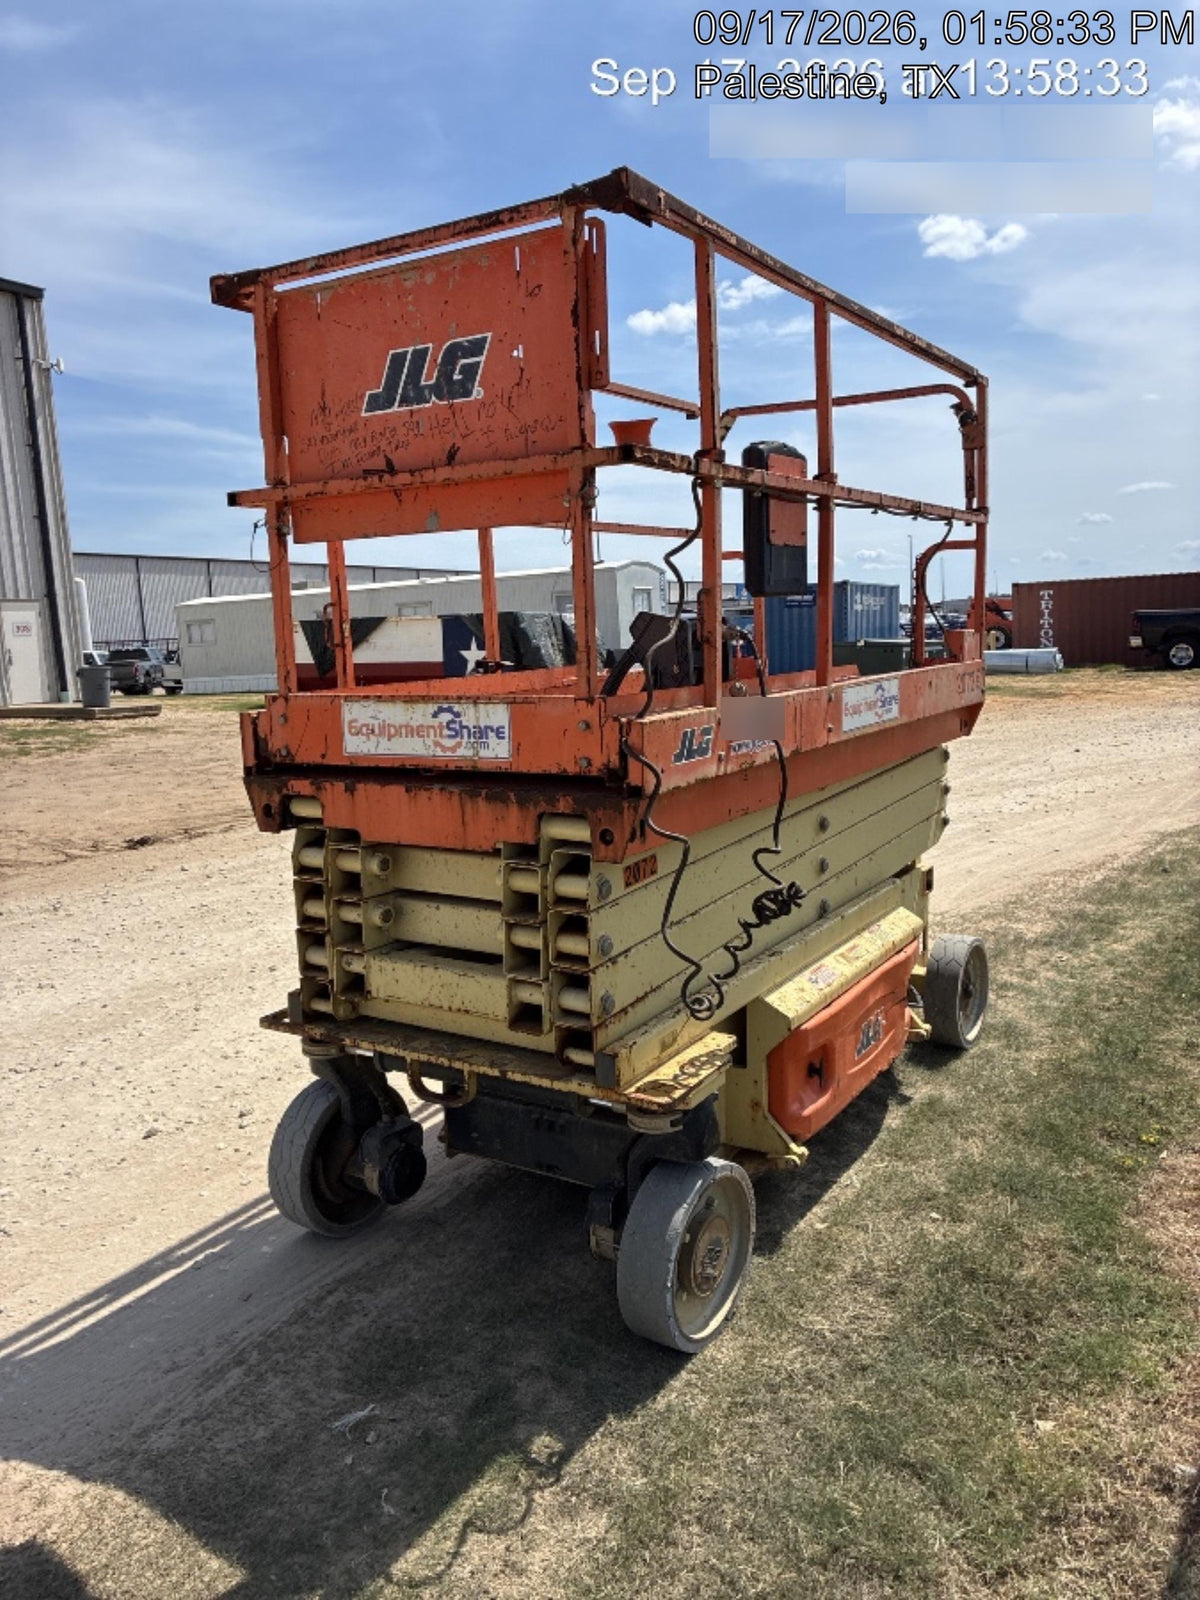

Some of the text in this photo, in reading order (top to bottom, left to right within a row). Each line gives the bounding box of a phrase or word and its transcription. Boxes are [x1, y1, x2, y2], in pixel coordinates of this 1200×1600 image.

[361, 332, 492, 416] JLG
[1039, 589, 1054, 648] TRITON
[671, 724, 715, 766] JLG
